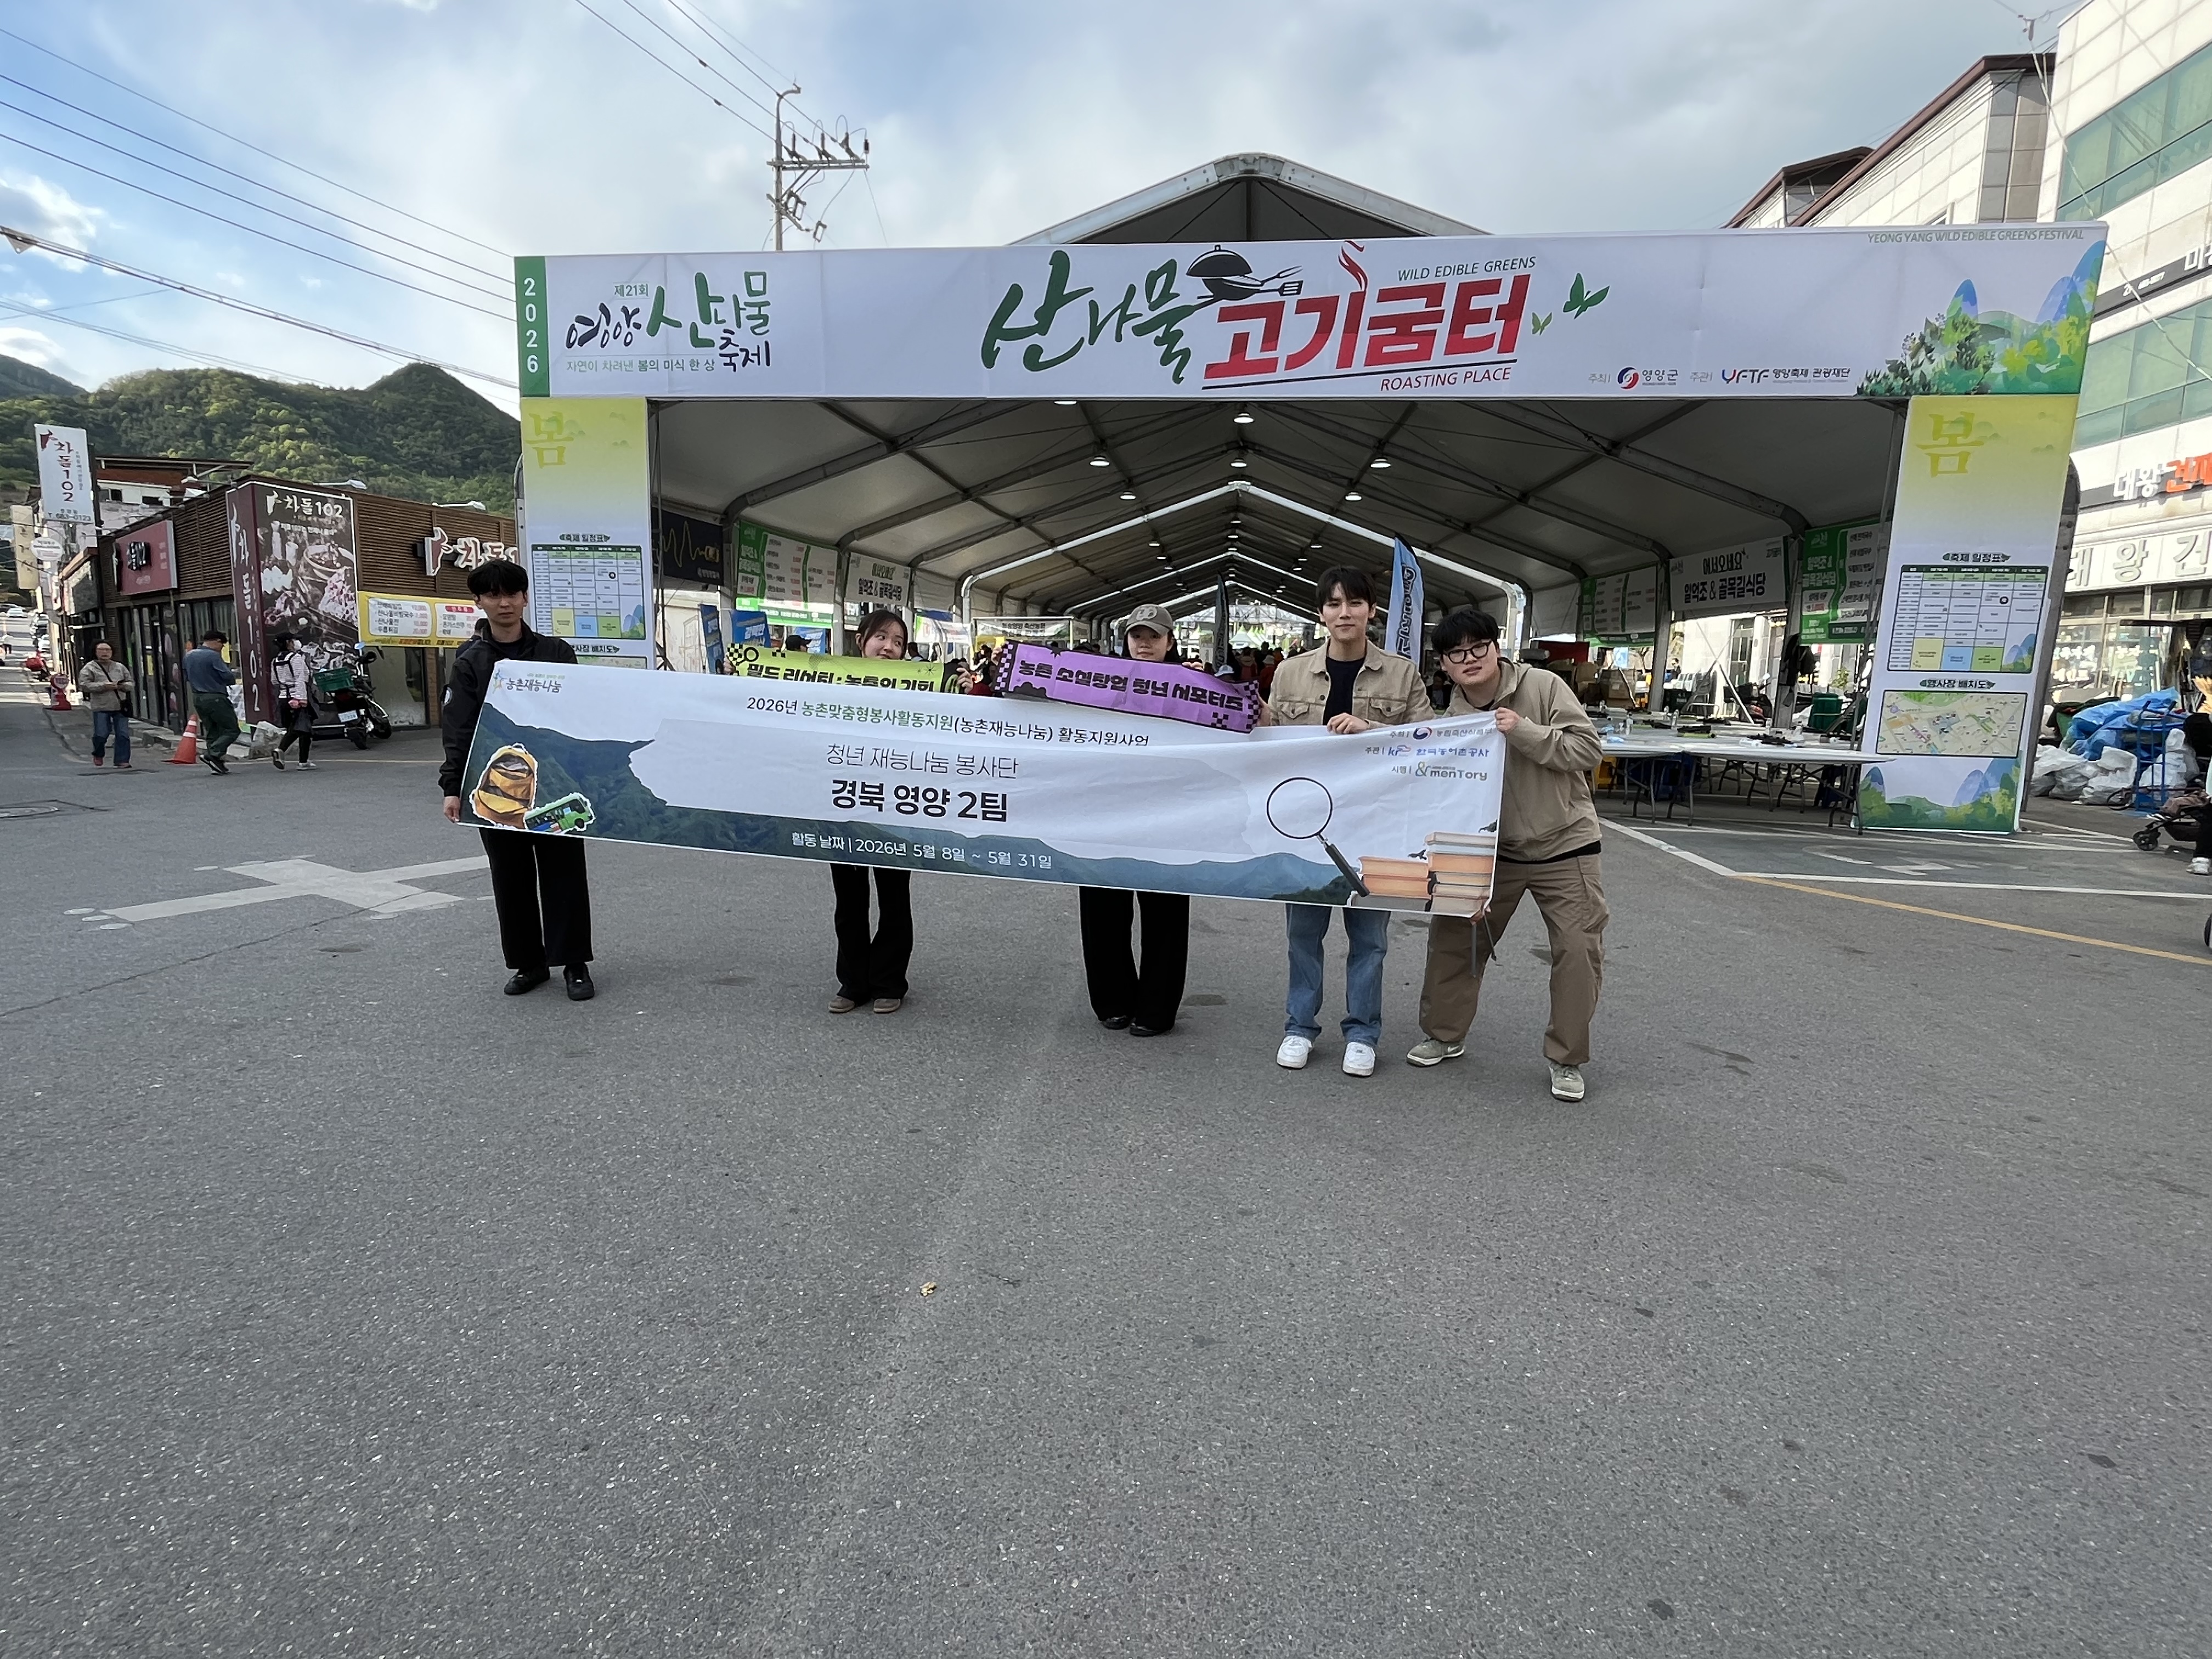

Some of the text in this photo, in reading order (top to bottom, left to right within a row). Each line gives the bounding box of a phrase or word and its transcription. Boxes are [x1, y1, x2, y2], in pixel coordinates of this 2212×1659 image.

[1868, 229, 2084, 243] YEONG YANG WILD EDIBLE GREENS FESTIVAL
[1397, 257, 1536, 281] WILD EDIBLE GREENS
[614, 284, 650, 297] 제21회
[524, 277, 539, 373] 2026
[566, 271, 771, 373] 영양 산나물 축제
[981, 250, 1196, 384] 산나물
[566, 359, 715, 373] 자연이 차려낸 봄의 미식 한 상
[1380, 368, 1511, 391] ROASTING PLACE
[1642, 369, 1678, 381] 영양군
[1772, 369, 1809, 379] 영양축제
[1812, 368, 1850, 379] 관광재단
[525, 411, 574, 470] 봄
[1916, 411, 1984, 478] 봄
[283, 495, 343, 518] 차돌102
[1709, 580, 1716, 600] &
[1719, 572, 1766, 600] 골목길식당
[747, 663, 781, 679] 필드
[506, 678, 563, 693] 농촌재능나눔
[1019, 660, 1244, 712] 농촌 소셜창업 청년 서포터즈
[747, 697, 798, 715] 2026년
[801, 701, 1053, 742] 농촌맞춤형봉사활동지원(농촌재능나눔)
[826, 743, 1019, 780] 청년 재능나눔 봉사단
[831, 779, 1008, 822] 경북 영양 2팀
[792, 832, 816, 847] 활동
[819, 835, 845, 850] 날짜
[855, 839, 906, 856] 2026년
[913, 845, 935, 860] 5월
[941, 847, 966, 862] 8일
[988, 851, 1012, 866] 5월
[1018, 853, 1052, 868] 31일
